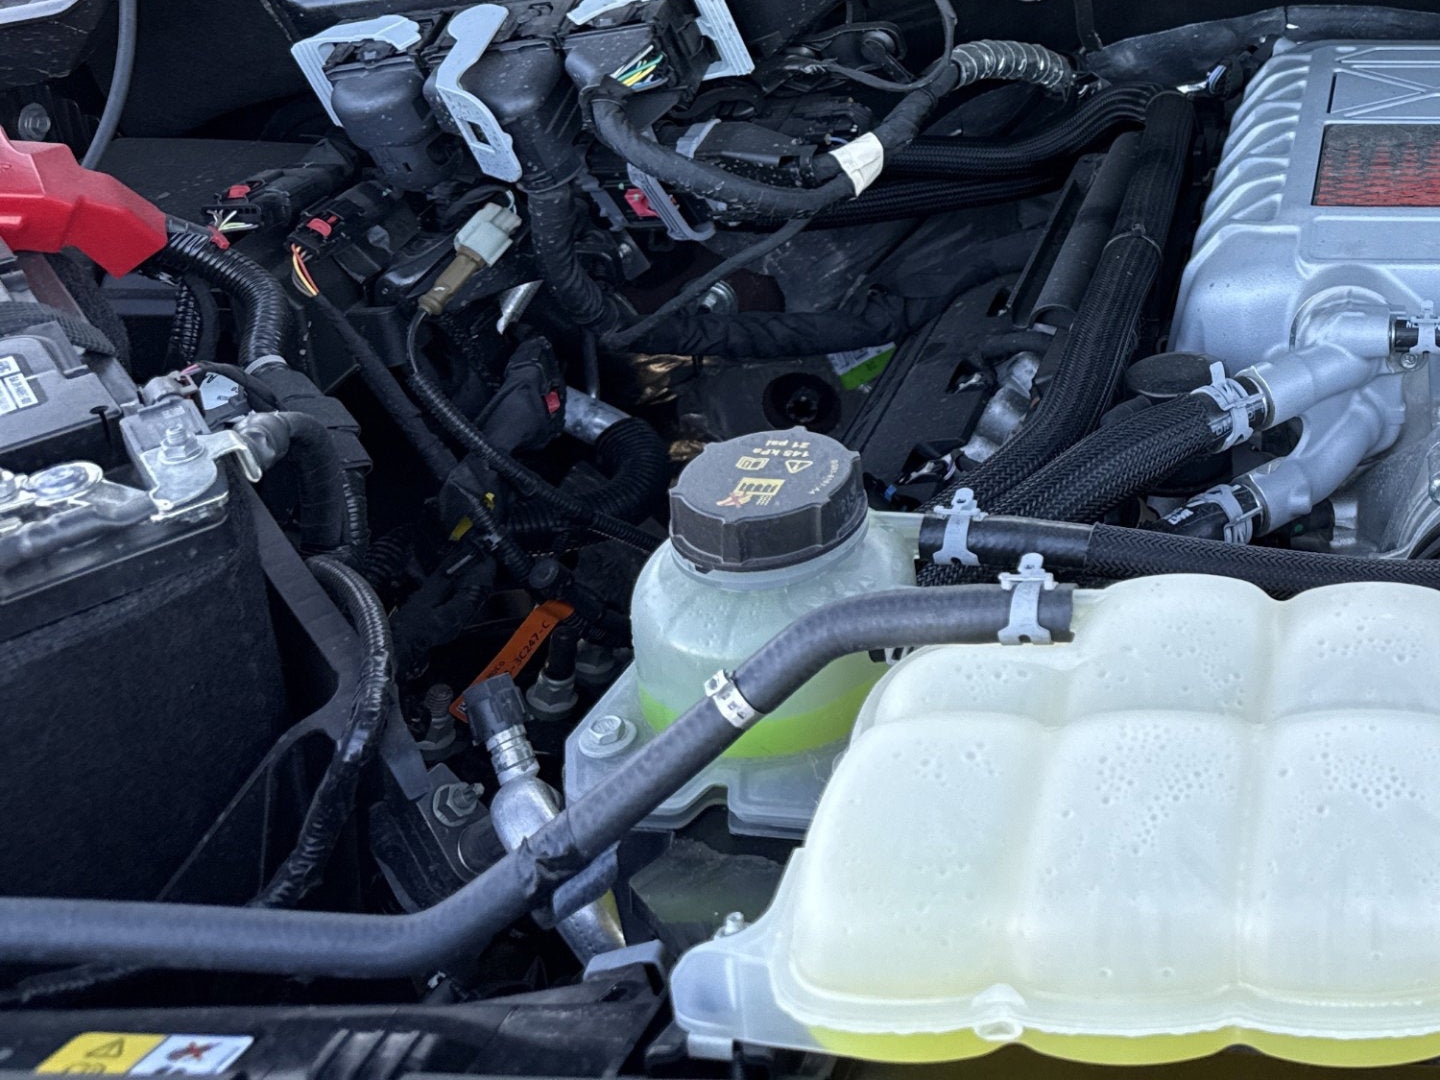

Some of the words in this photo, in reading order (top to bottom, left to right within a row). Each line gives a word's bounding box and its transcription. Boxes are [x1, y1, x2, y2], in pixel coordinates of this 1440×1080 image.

[765, 439, 789, 447] psi
[752, 448, 780, 456] kPa
[783, 450, 810, 458] 145
